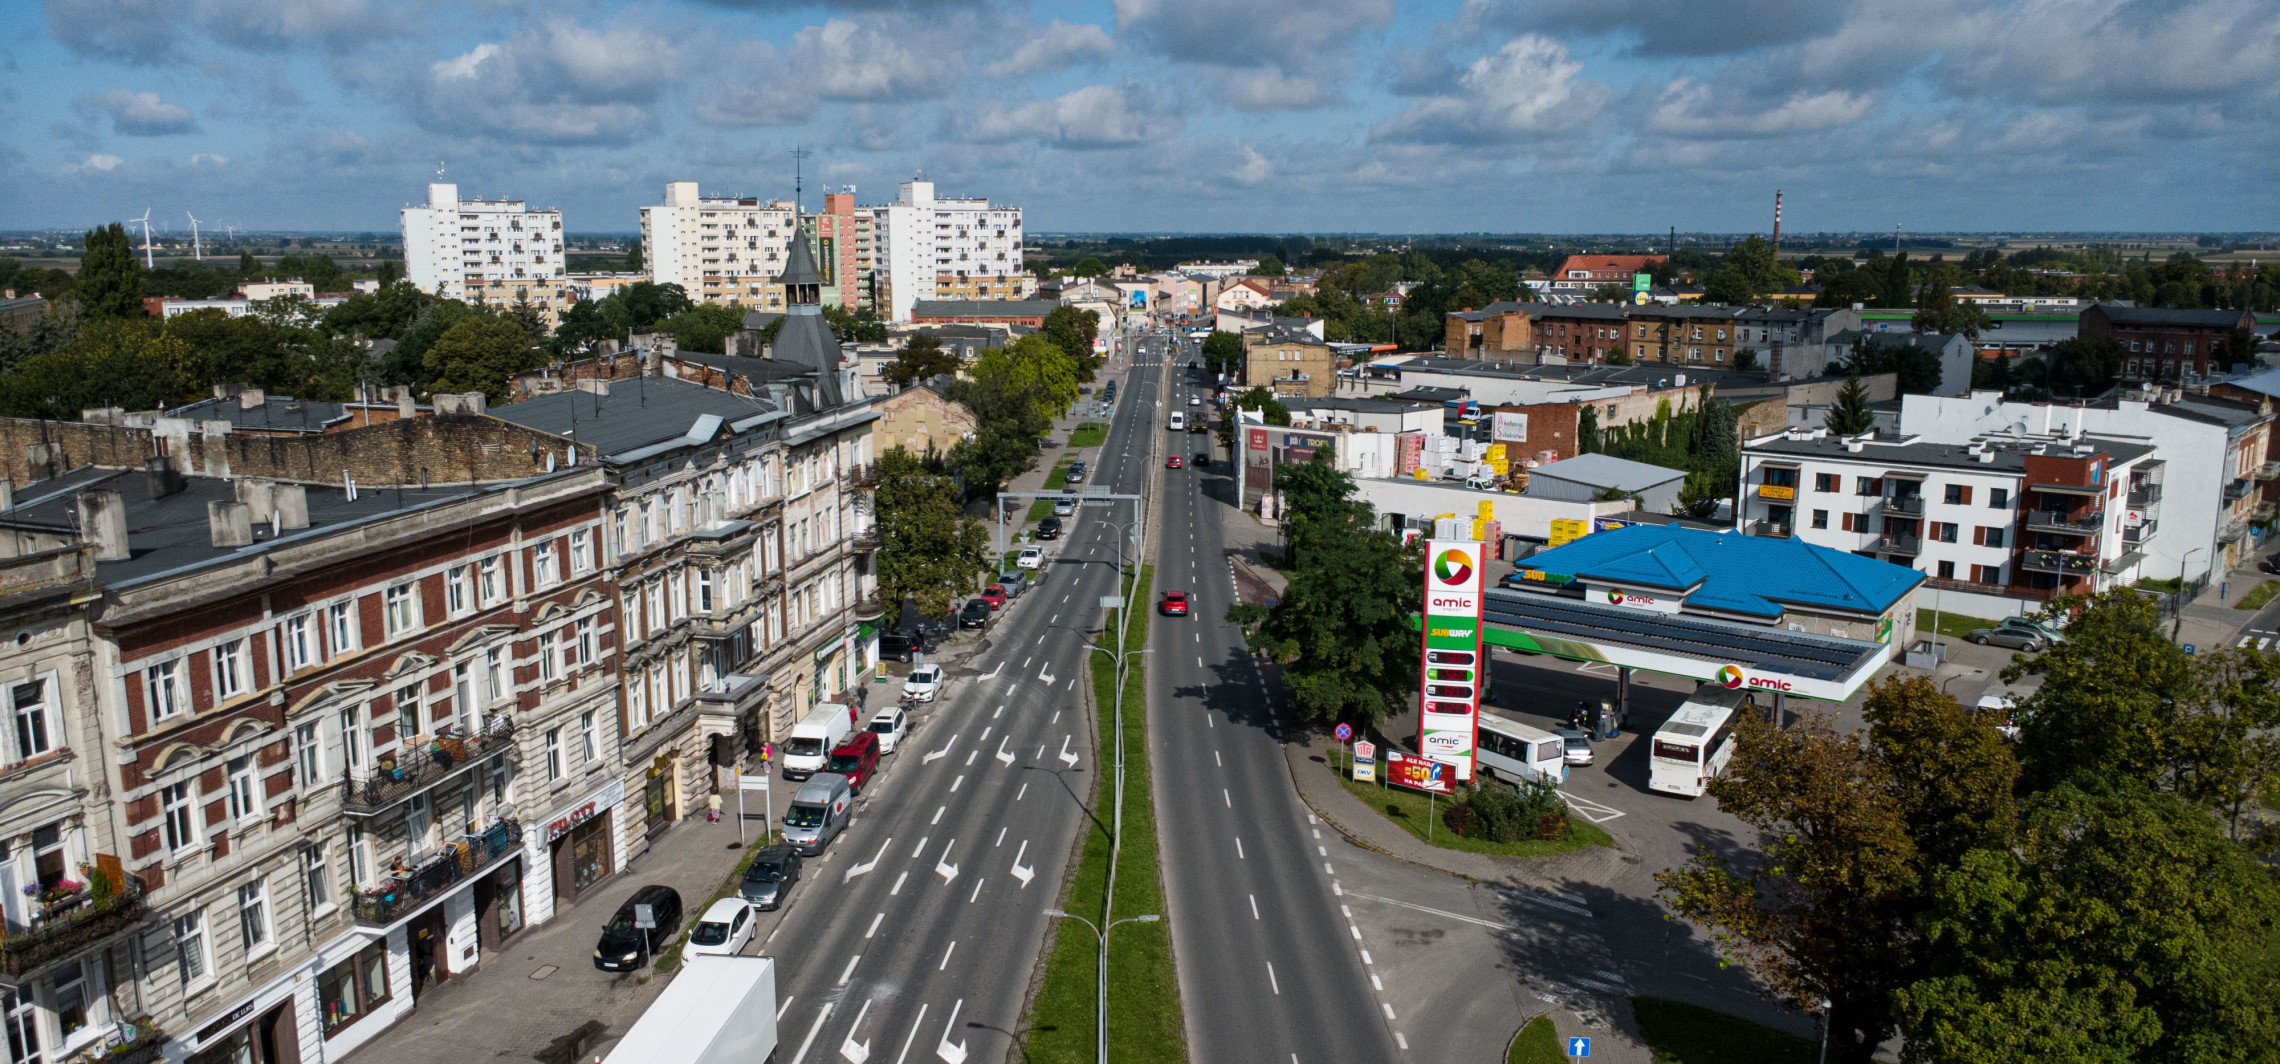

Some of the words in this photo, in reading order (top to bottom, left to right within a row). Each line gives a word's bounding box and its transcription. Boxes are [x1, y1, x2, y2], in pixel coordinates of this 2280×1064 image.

[1432, 597, 1472, 608] amic
[1627, 595, 1655, 605] amic
[1430, 628, 1473, 638] SUBWAY
[1749, 677, 1793, 692] amic
[1429, 736, 1460, 745] amic
[1356, 743, 1373, 756] UTA
